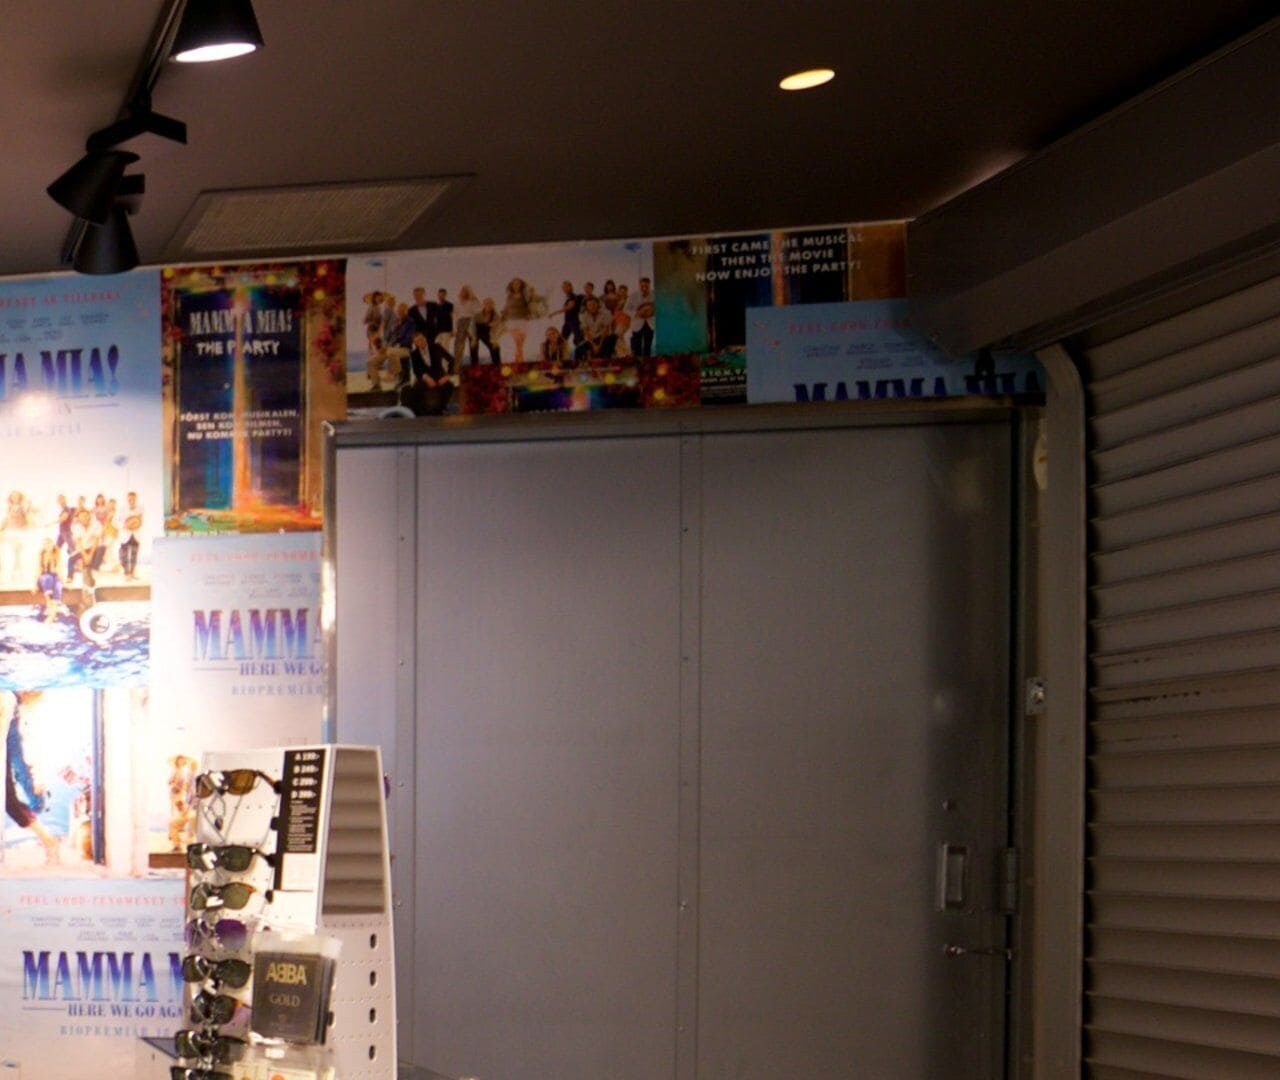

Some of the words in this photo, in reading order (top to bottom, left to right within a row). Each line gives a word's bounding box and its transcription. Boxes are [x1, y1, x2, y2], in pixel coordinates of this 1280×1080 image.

[731, 240, 771, 252] CAME
[721, 256, 756, 267] THEN
[790, 248, 835, 261] MOVIE
[695, 270, 730, 282] NOW
[197, 341, 223, 355] THE
[40, 344, 121, 399] MIA!
[22, 951, 160, 1003] MAMMA
[266, 962, 308, 986] ABBA
[68, 1003, 105, 1017] HERE
[110, 1004, 132, 1017] WE
[136, 1004, 155, 1018] GO
[159, 1004, 184, 1018] AGA
